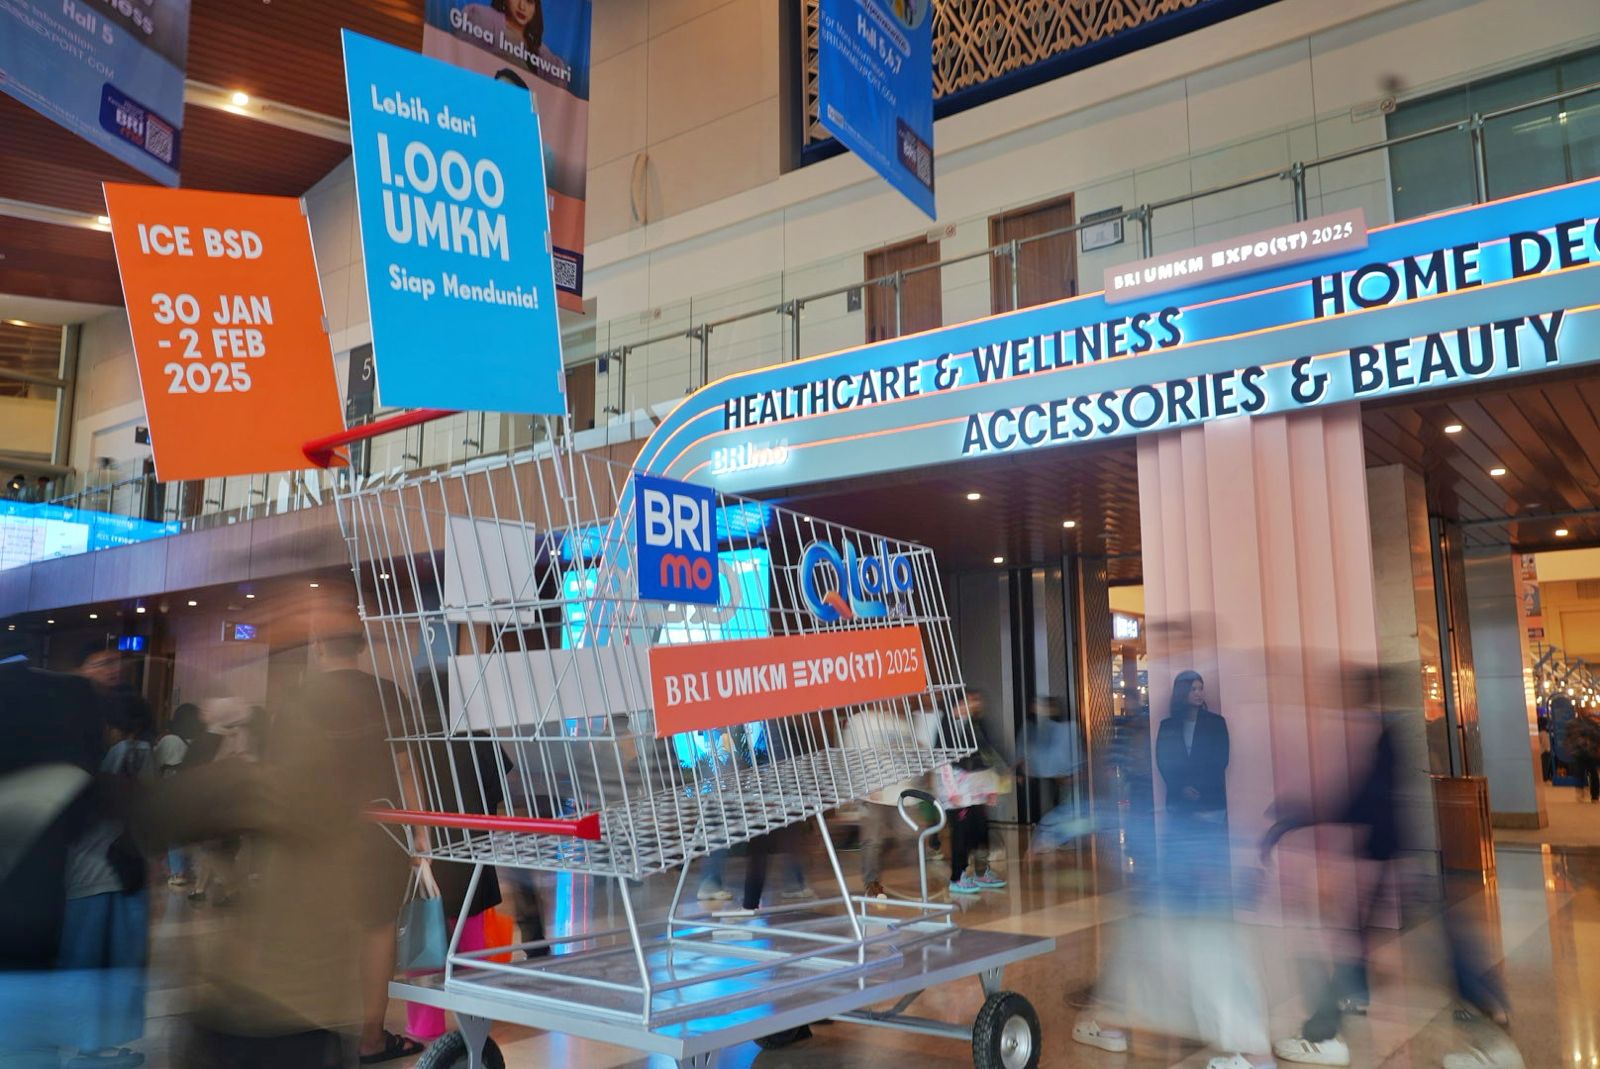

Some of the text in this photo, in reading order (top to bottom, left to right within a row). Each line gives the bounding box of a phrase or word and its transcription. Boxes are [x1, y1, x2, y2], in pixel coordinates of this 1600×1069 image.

[63, 0, 96, 34] Hall
[449, 7, 572, 83] Ghea Indrawari
[370, 84, 477, 138] Lebih dari
[138, 223, 263, 260] ICE BSD
[382, 189, 510, 262] UMKM
[1113, 271, 1141, 290] BRI
[1144, 255, 1203, 283] UMKM
[1311, 221, 1353, 246] 2025
[1312, 217, 1600, 319] HOME DE
[151, 292, 274, 325] 30 JAN
[388, 263, 539, 309] Siap Mendunia!
[178, 328, 203, 359] 2
[211, 328, 267, 358] FEB
[361, 358, 372, 381] 5
[723, 306, 1184, 430] HEALTHCARE & WELLNESS
[163, 361, 252, 394] 2025
[962, 309, 1566, 455] ACCESSORIES & BEAUTY
[643, 489, 711, 553] BRI
[660, 553, 713, 590] mo
[664, 648, 919, 706] BRI UMKM EXPO(RT) 2025
